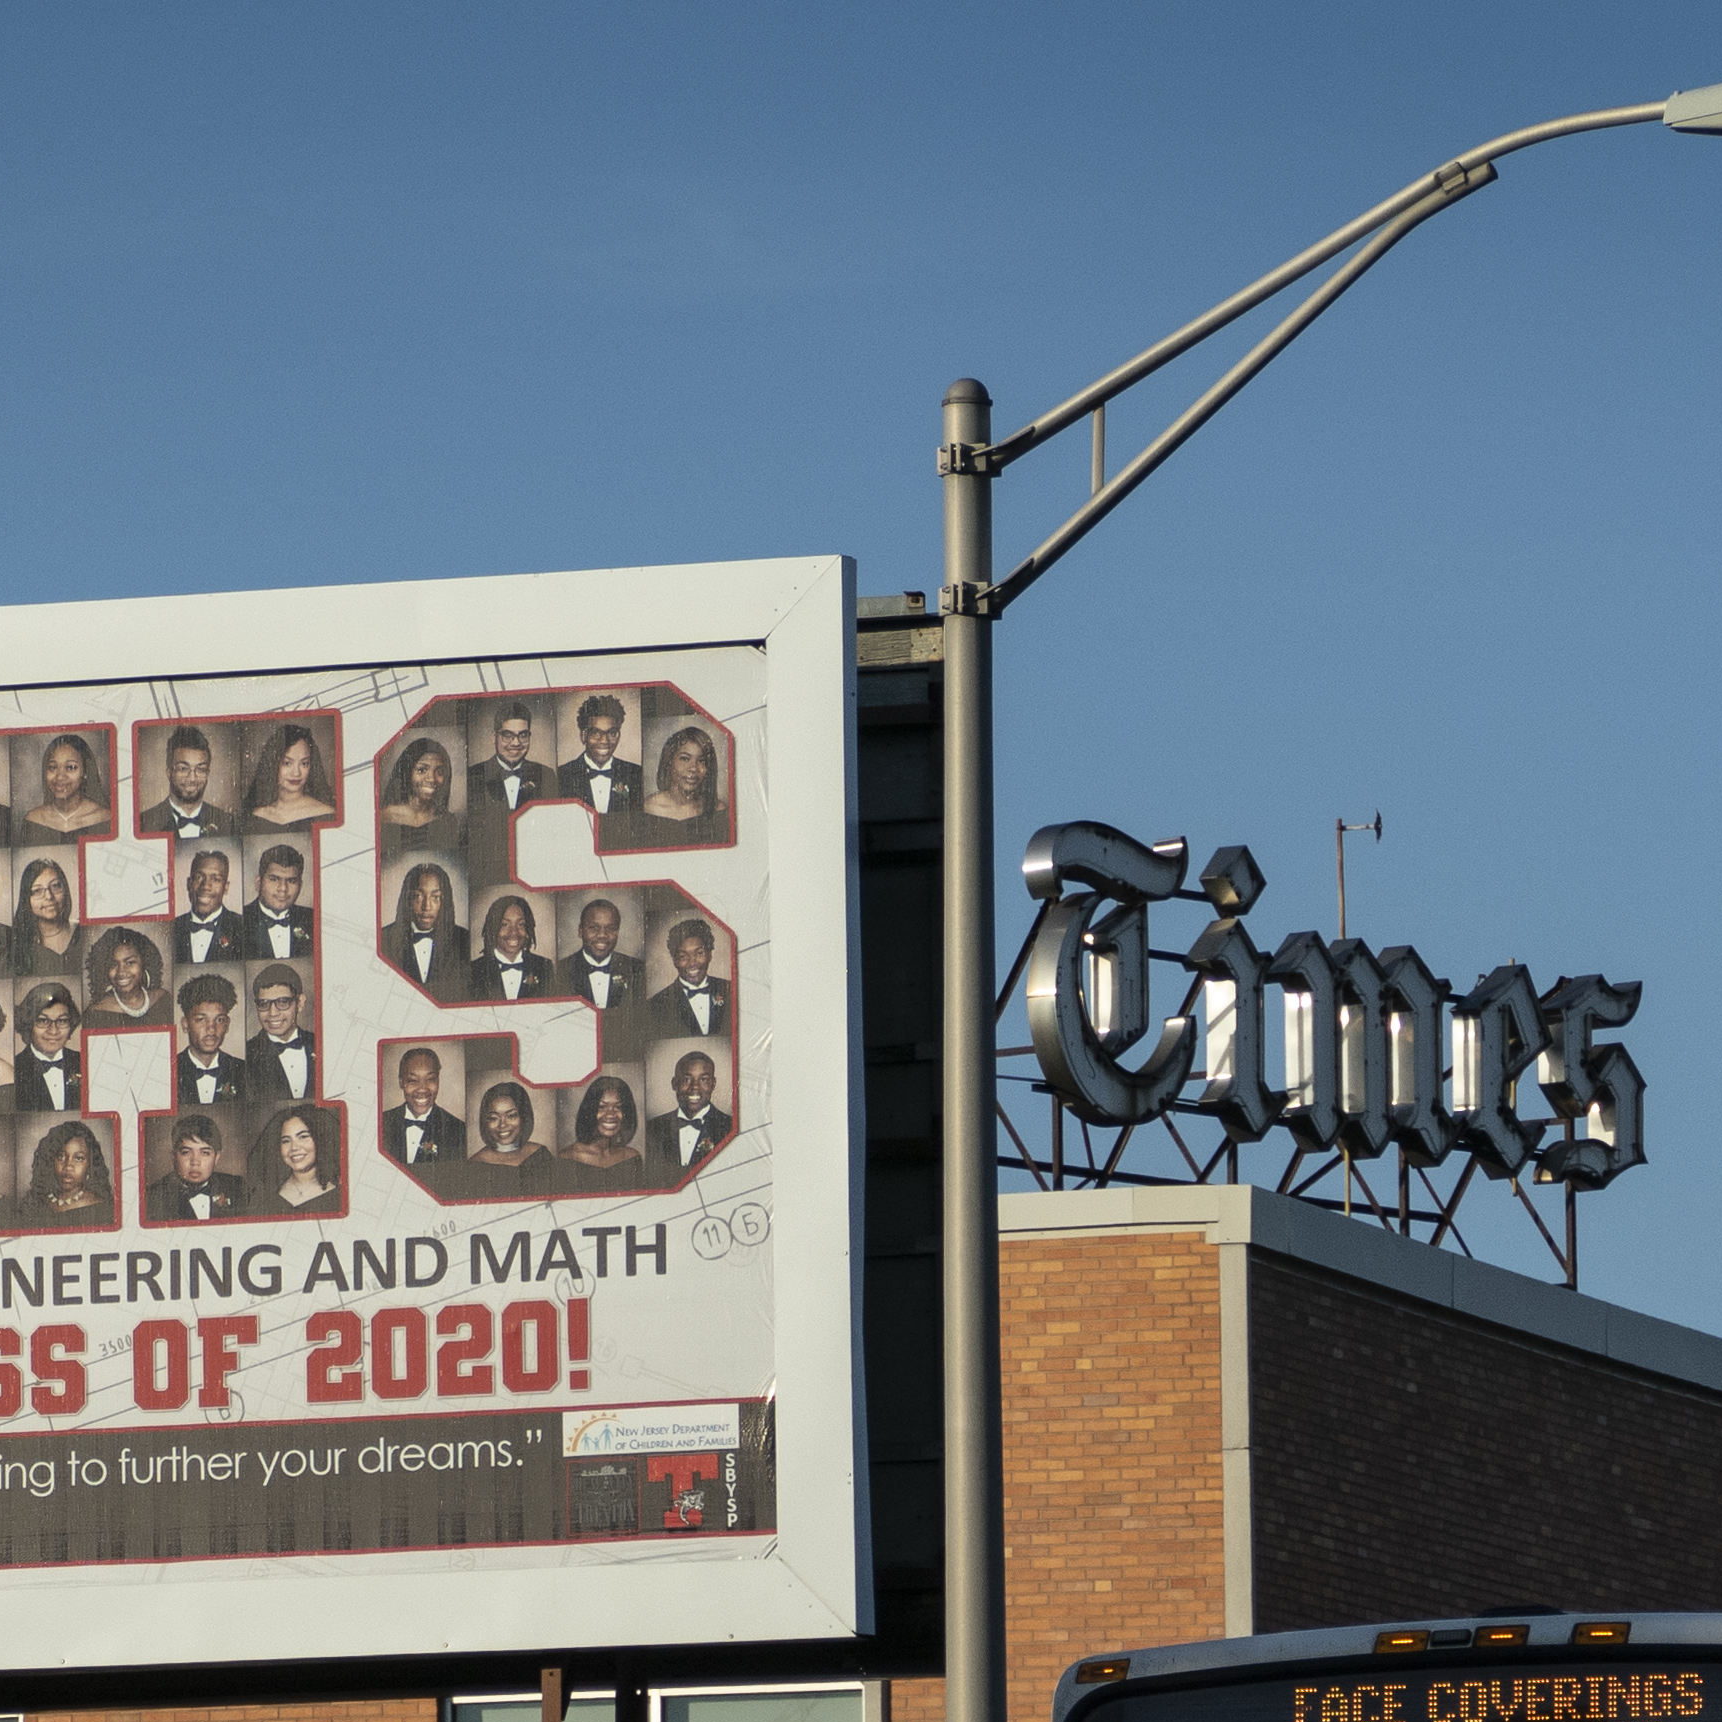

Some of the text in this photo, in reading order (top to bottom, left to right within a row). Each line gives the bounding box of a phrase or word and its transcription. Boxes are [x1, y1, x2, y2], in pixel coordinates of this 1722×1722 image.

[1021, 820, 1649, 1192] Times
[302, 1236, 448, 1293] AND
[470, 1223, 667, 1285] MATH
[702, 1223, 724, 1248] 11
[132, 1314, 260, 1411] OF
[304, 1297, 591, 1403] 2020!
[67, 1450, 108, 1486] to
[118, 1445, 248, 1484] further
[257, 1447, 348, 1487] your
[357, 1430, 544, 1474] dreams.”
[724, 1452, 739, 1528] SBYSP
